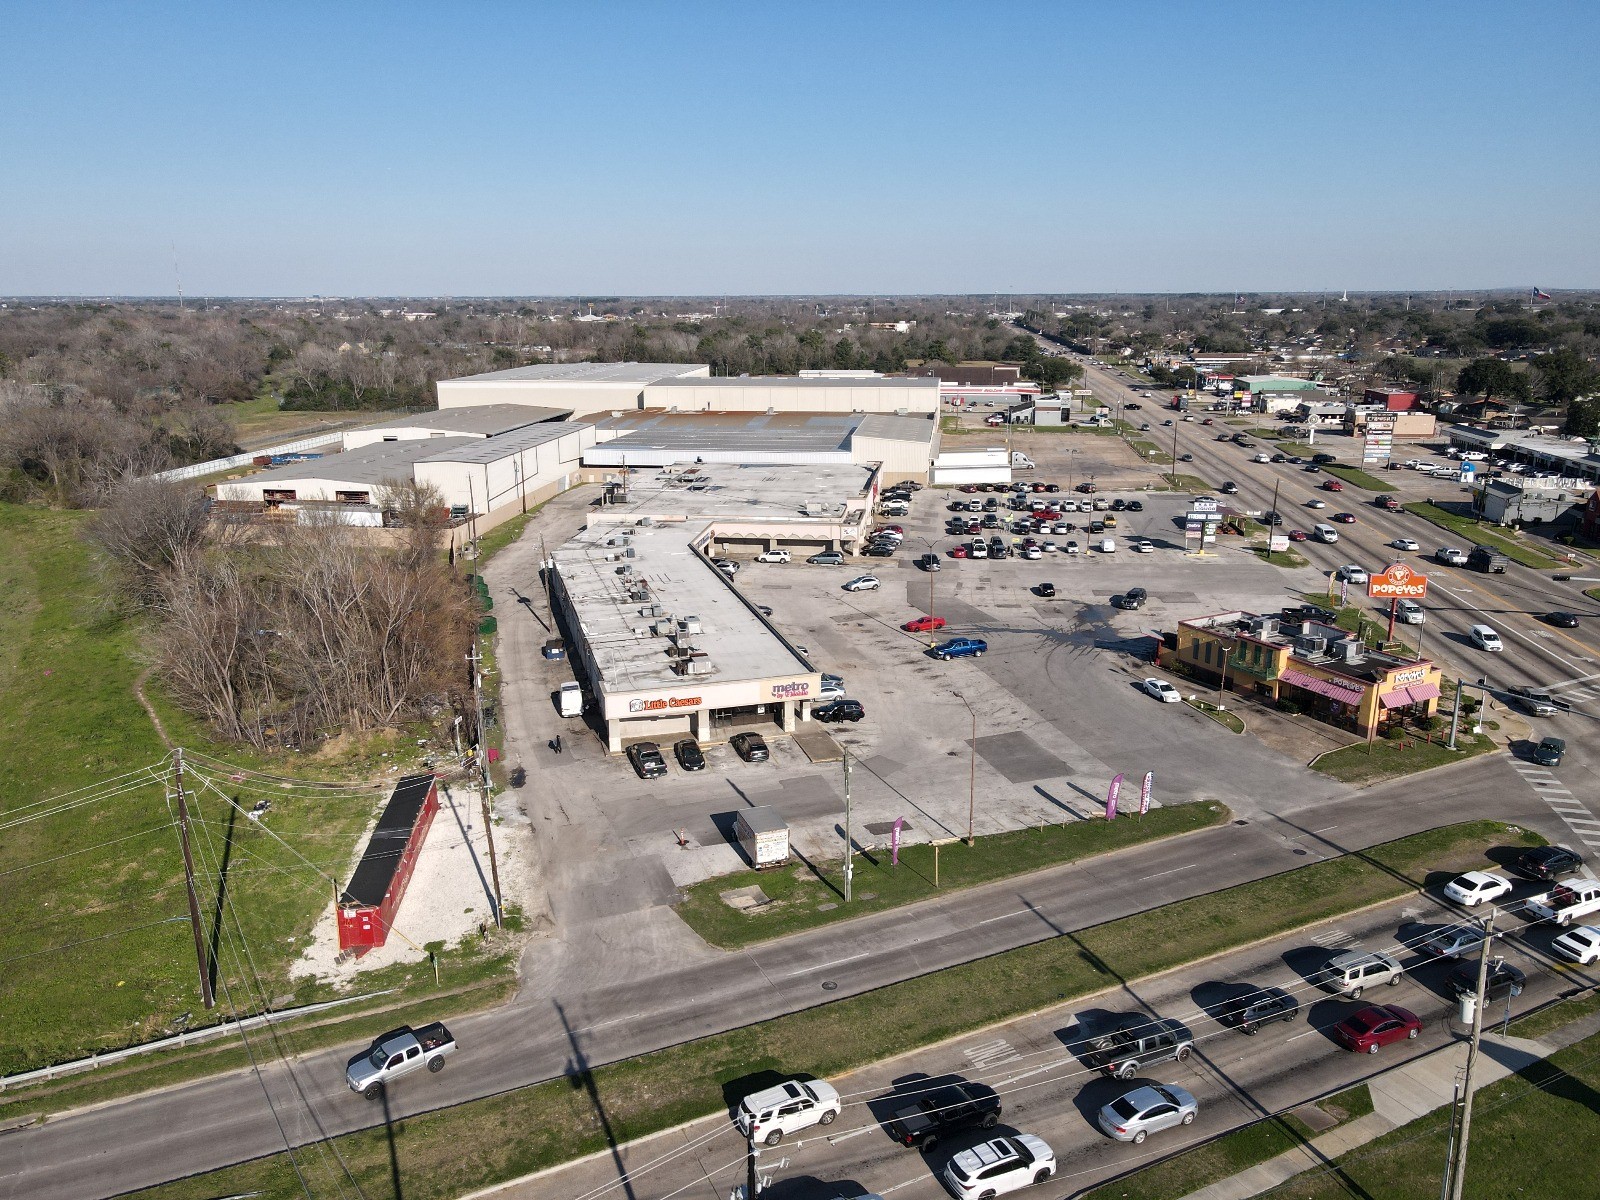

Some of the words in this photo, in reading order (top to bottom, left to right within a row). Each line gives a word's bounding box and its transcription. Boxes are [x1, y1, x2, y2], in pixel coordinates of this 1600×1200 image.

[772, 681, 809, 693] metro
[644, 699, 668, 710] Little
[669, 697, 702, 707] Caesars
[963, 1039, 1024, 1072] ONLY
